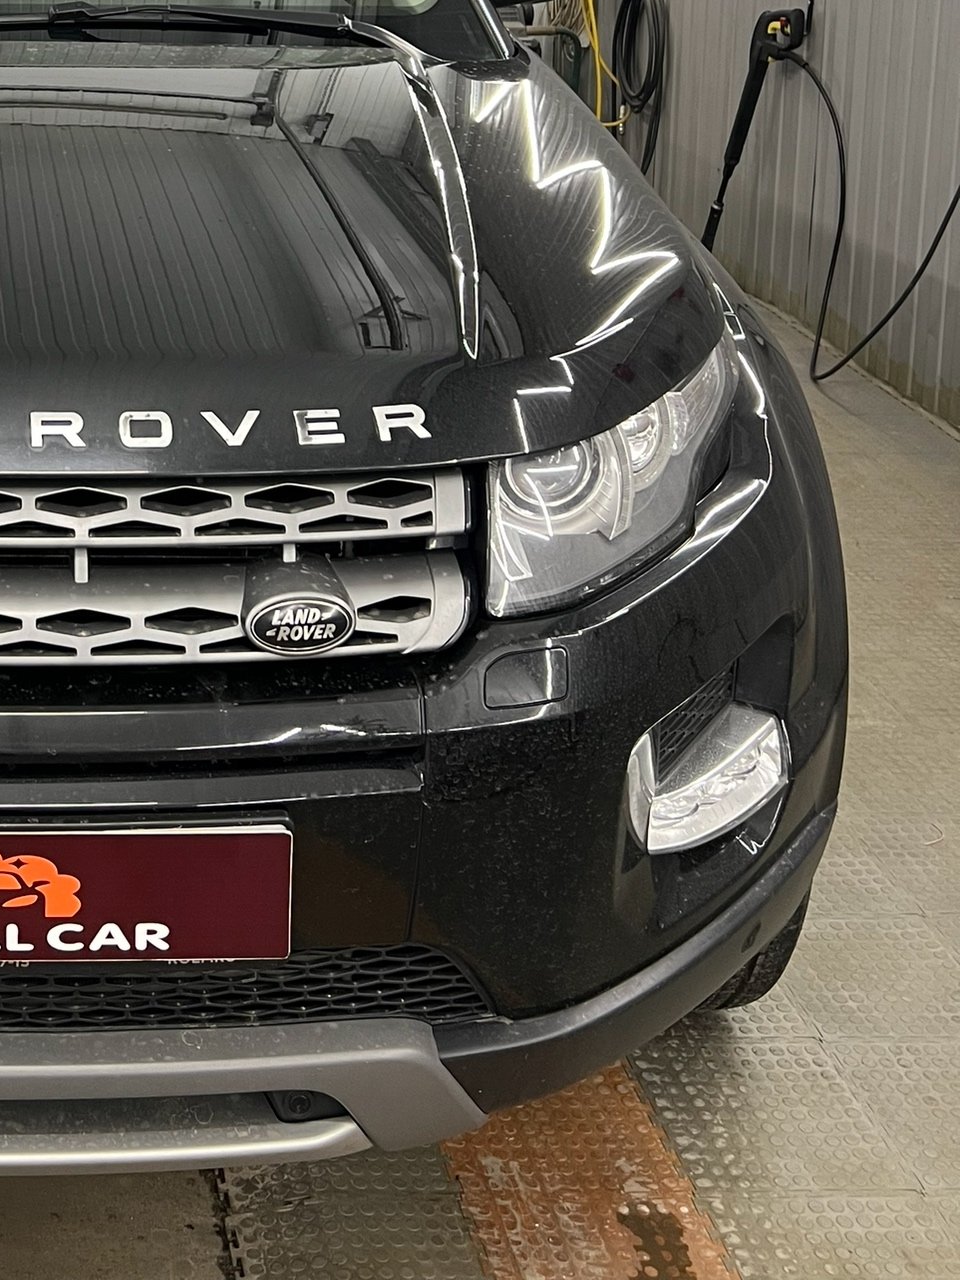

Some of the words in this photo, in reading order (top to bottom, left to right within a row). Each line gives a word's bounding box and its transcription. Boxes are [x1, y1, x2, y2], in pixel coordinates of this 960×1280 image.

[29, 403, 433, 448] ROVER
[271, 607, 321, 626] LAND
[276, 623, 337, 641] ROVER
[46, 921, 171, 953] CAR
